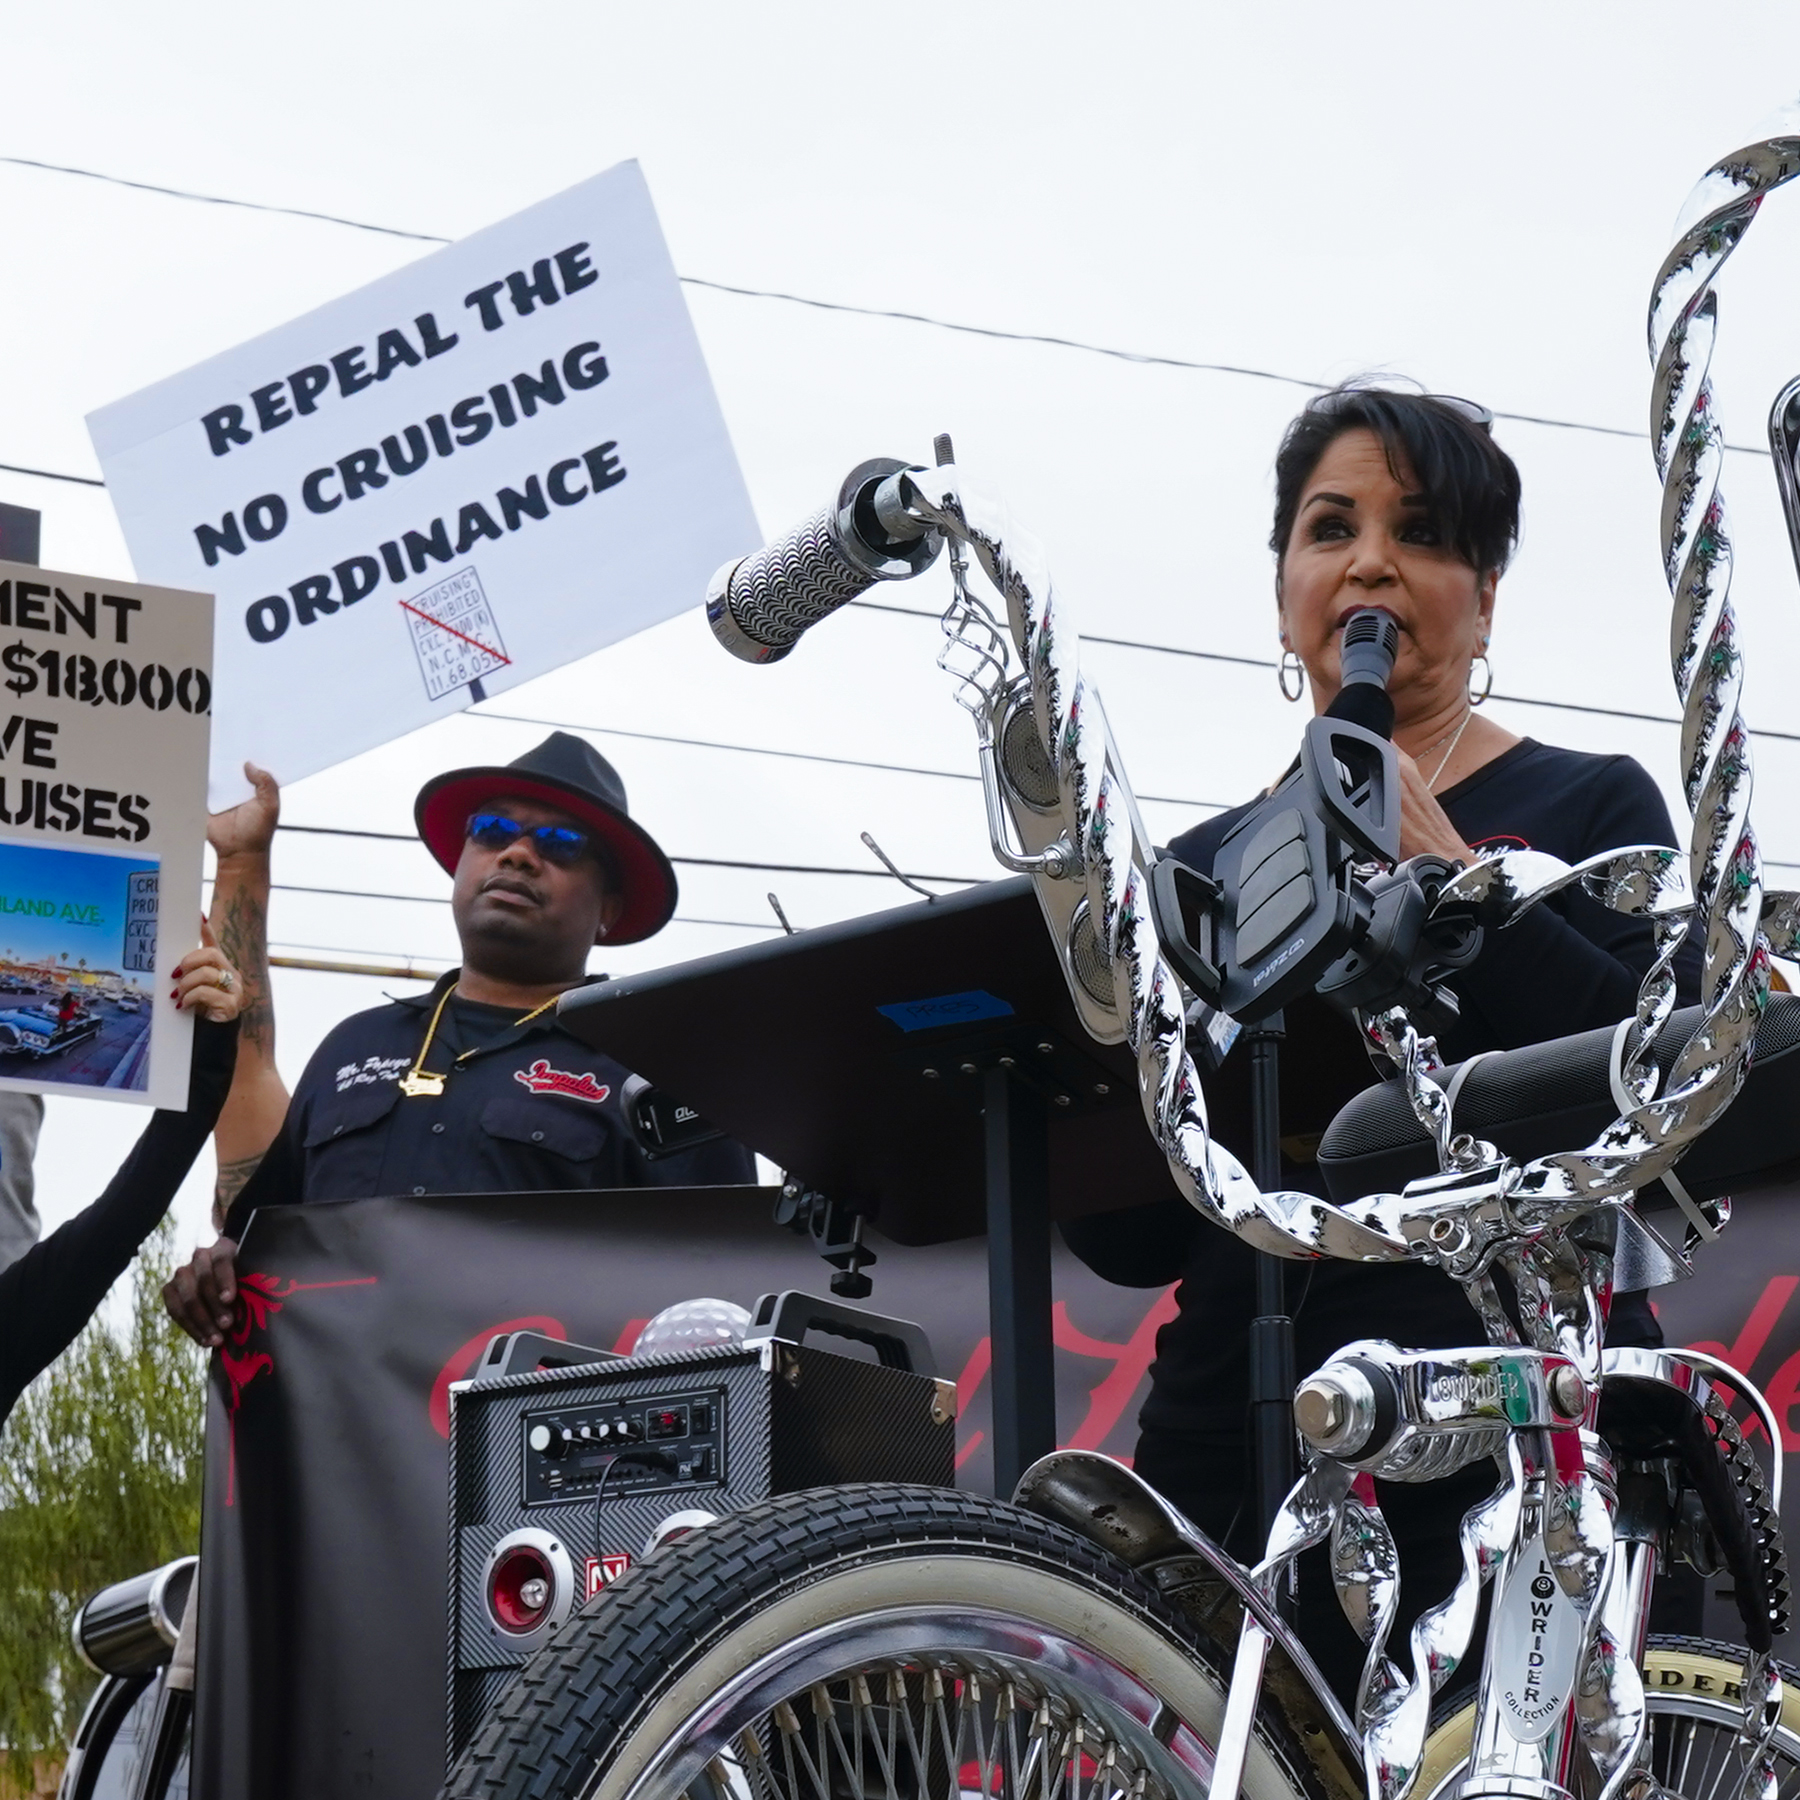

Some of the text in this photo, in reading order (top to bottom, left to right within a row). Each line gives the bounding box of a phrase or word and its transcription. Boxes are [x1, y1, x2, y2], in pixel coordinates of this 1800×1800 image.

[200, 240, 600, 457] REPEAL THE
[193, 340, 611, 567] NO CRUISING
[243, 439, 628, 645] ORDINANCE
[1504, 1690, 1561, 1720] COLLECTION
[1643, 1669, 1742, 1700] IDER
